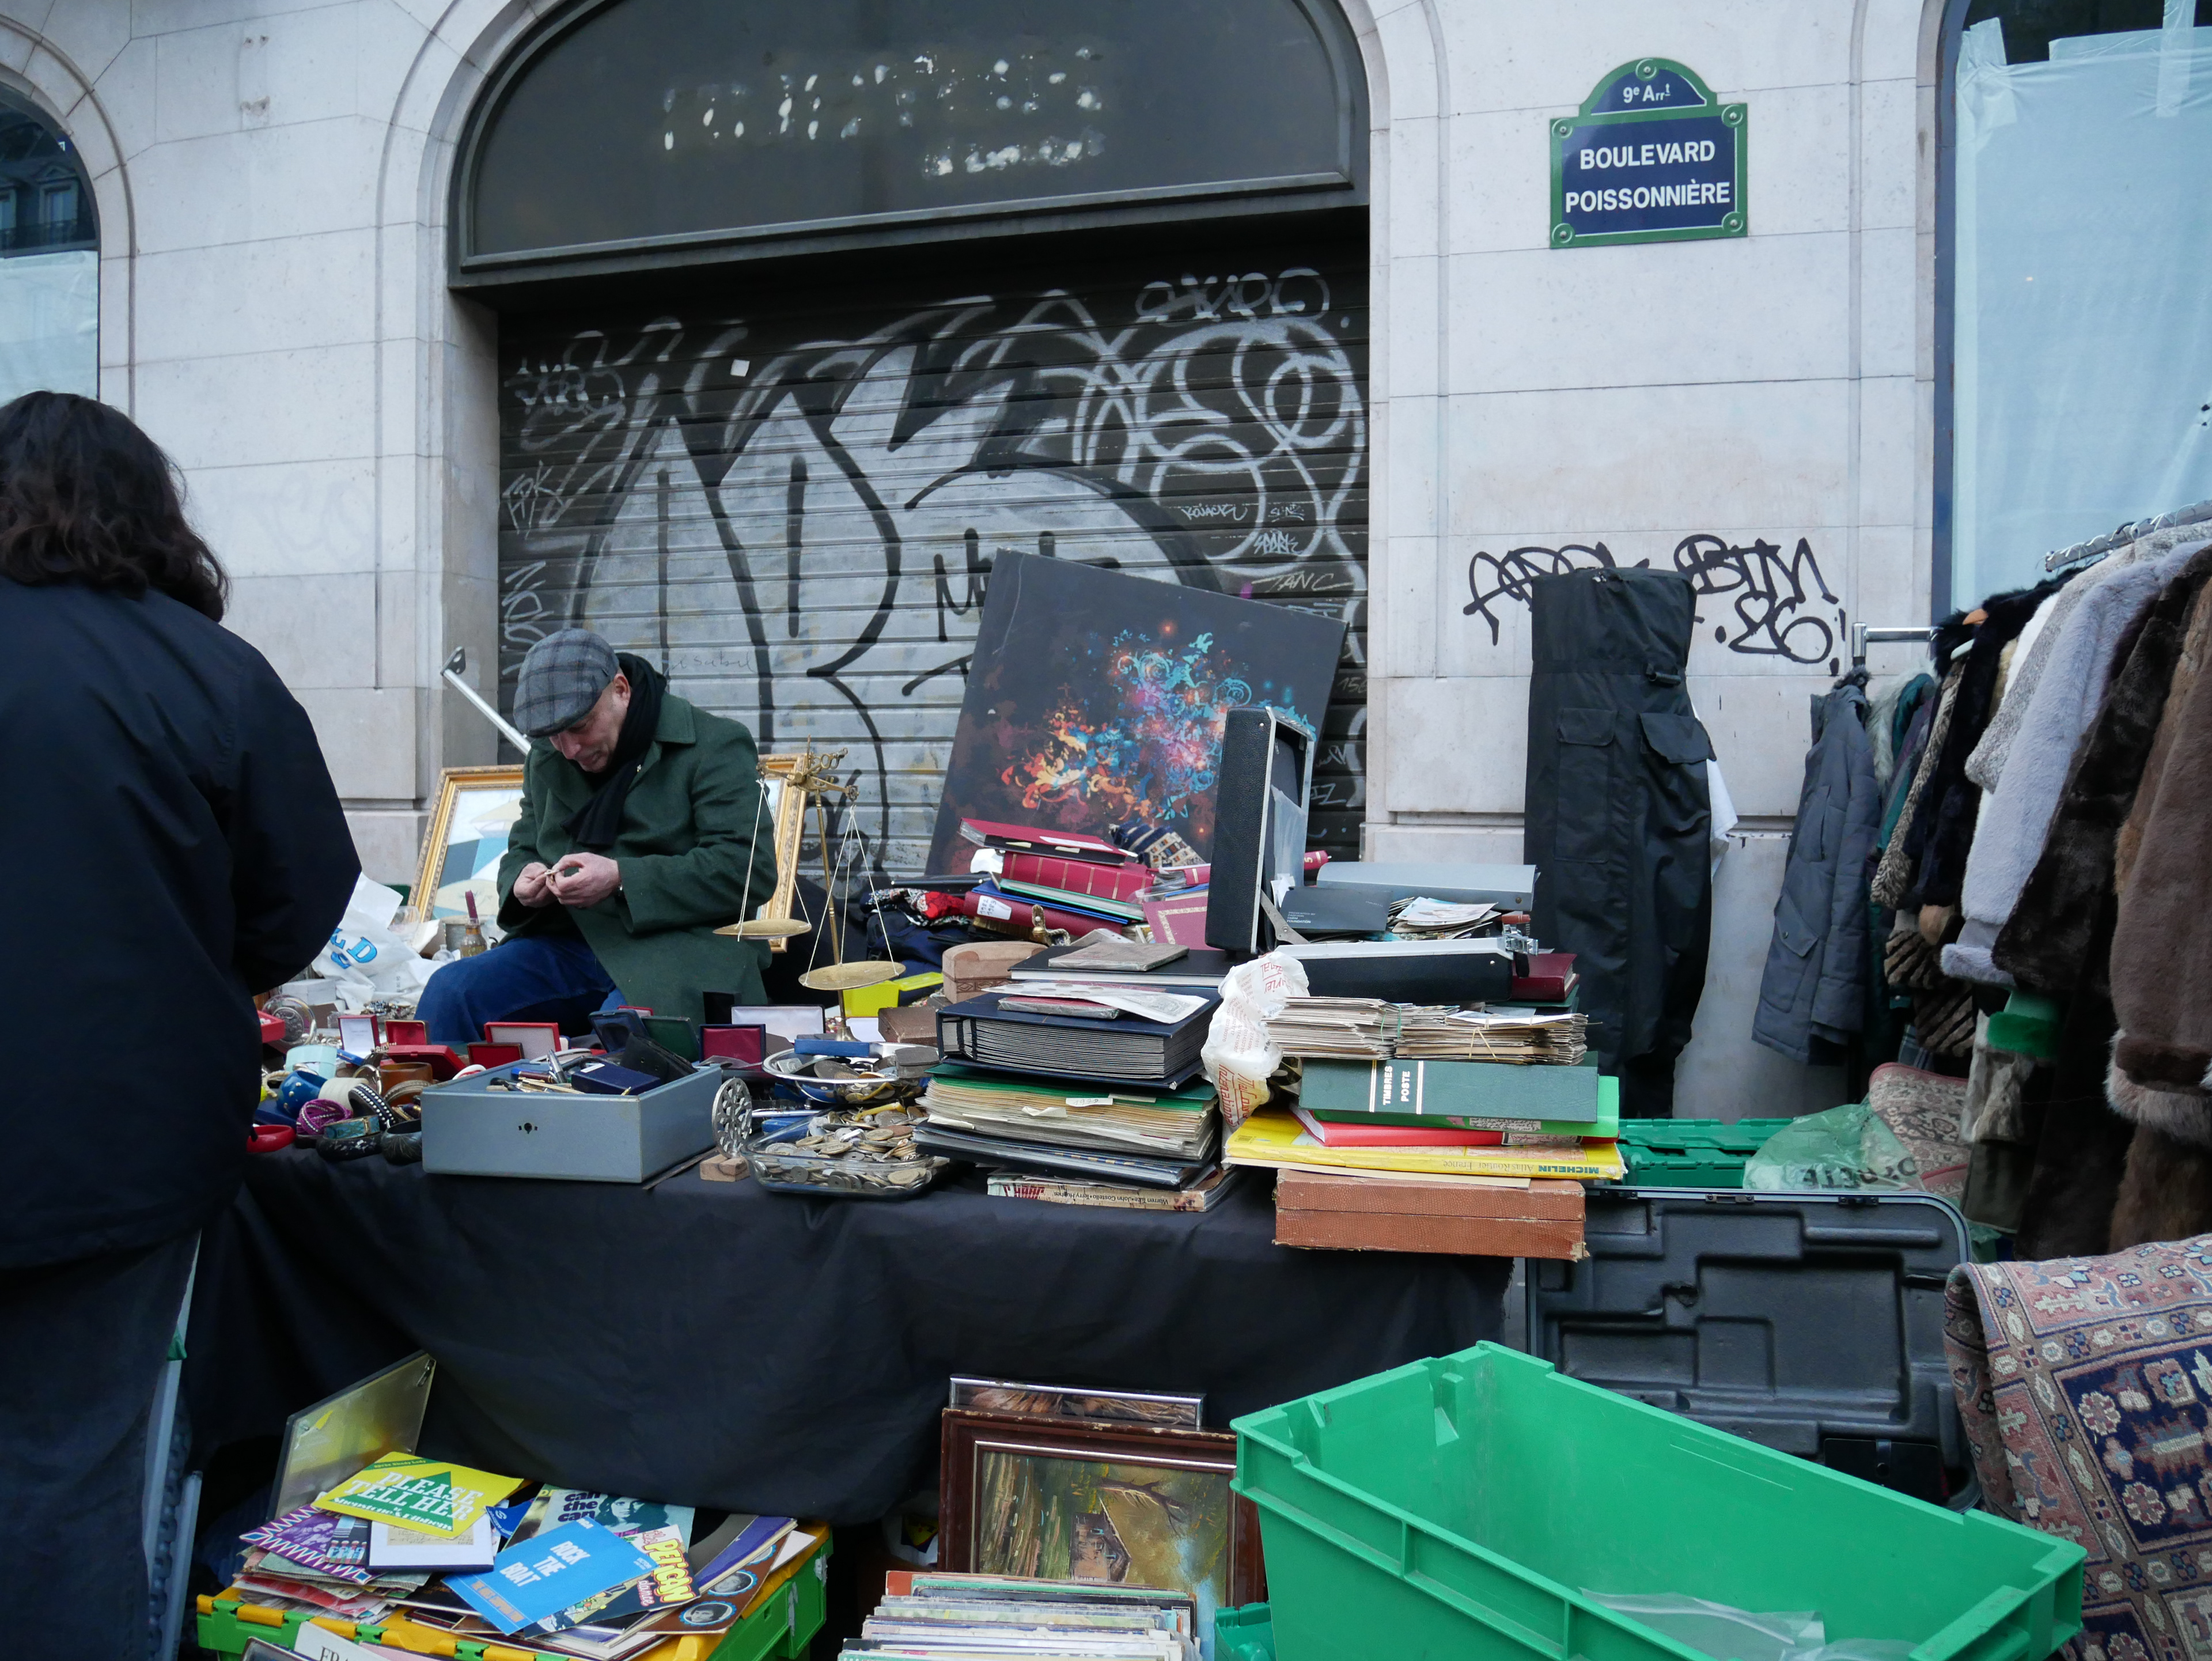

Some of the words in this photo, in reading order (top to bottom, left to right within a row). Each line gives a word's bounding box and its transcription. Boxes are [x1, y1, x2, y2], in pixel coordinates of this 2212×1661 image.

[1580, 140, 1715, 170] BOULEVARD
[1565, 178, 1730, 213] POISSONNIÈRE
[1382, 1065, 1393, 1106] TIMBRES
[1400, 1070, 1411, 1102] POSTE
[1442, 1160, 1472, 1172] France
[1477, 1162, 1510, 1172] Routier
[1512, 1163, 1534, 1173] Atlas
[1538, 1164, 1600, 1175] MICHELIN
[1147, 1197, 1169, 1205] Warren
[344, 1480, 412, 1507] TELL
[375, 1471, 485, 1505] PLEASE
[564, 1490, 601, 1502] can
[409, 1496, 475, 1521] HER
[557, 1510, 596, 1522] can
[563, 1499, 598, 1512] the
[549, 1540, 591, 1565] ROCK
[499, 1562, 541, 1587] BOAT
[532, 1556, 567, 1577] THE
[637, 1579, 656, 1607] dance
